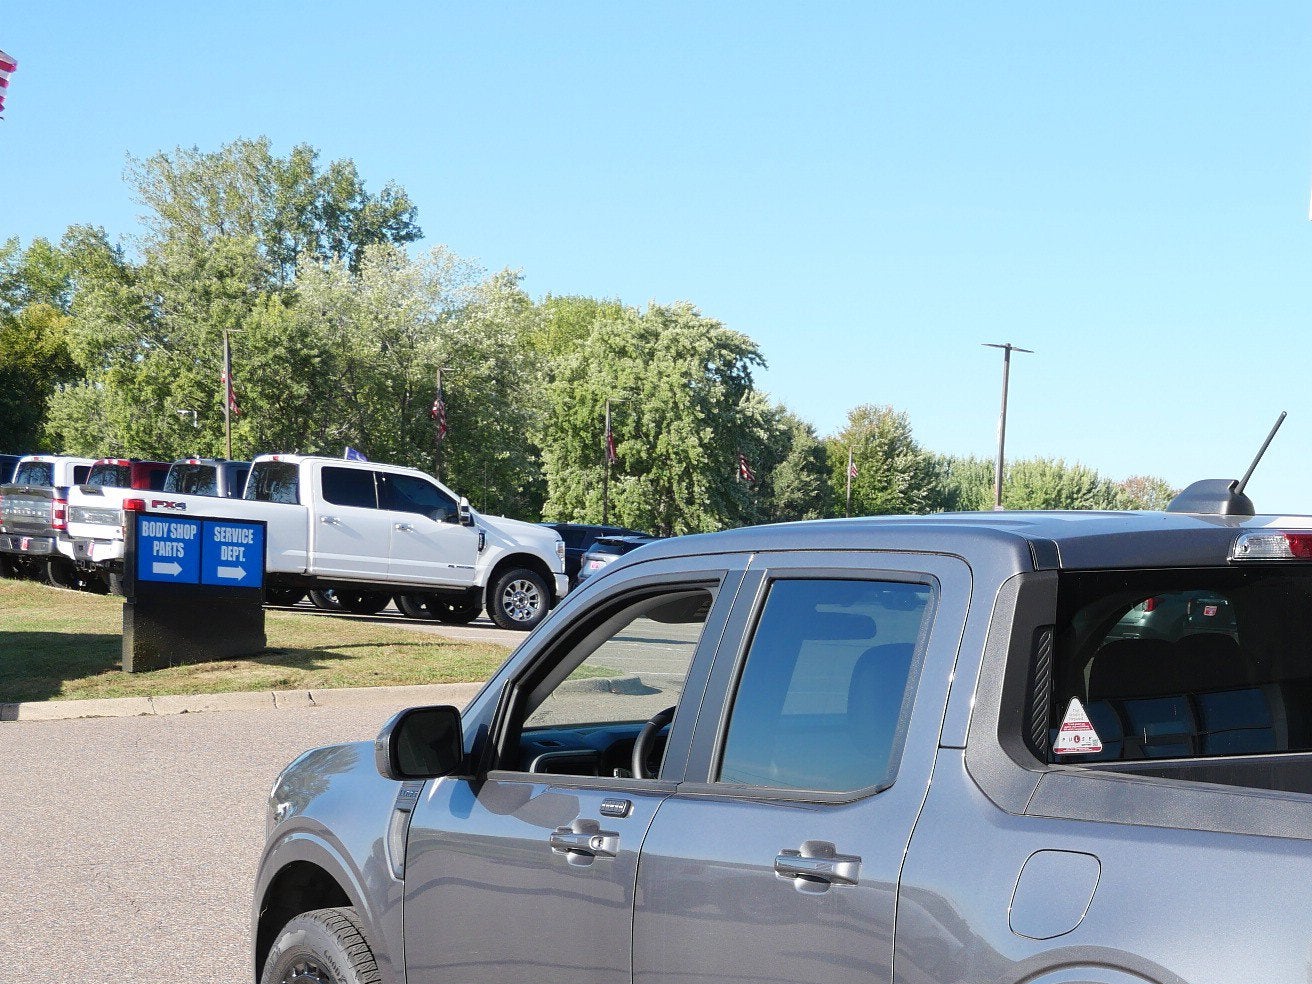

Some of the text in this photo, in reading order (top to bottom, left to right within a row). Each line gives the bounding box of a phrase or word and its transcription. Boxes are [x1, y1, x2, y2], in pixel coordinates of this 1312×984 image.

[151, 499, 187, 511] FX4
[142, 520, 197, 540] BODY SHOP
[213, 526, 254, 544] SERVICE
[153, 540, 184, 558] PARTS
[220, 545, 246, 562] DEPT.
